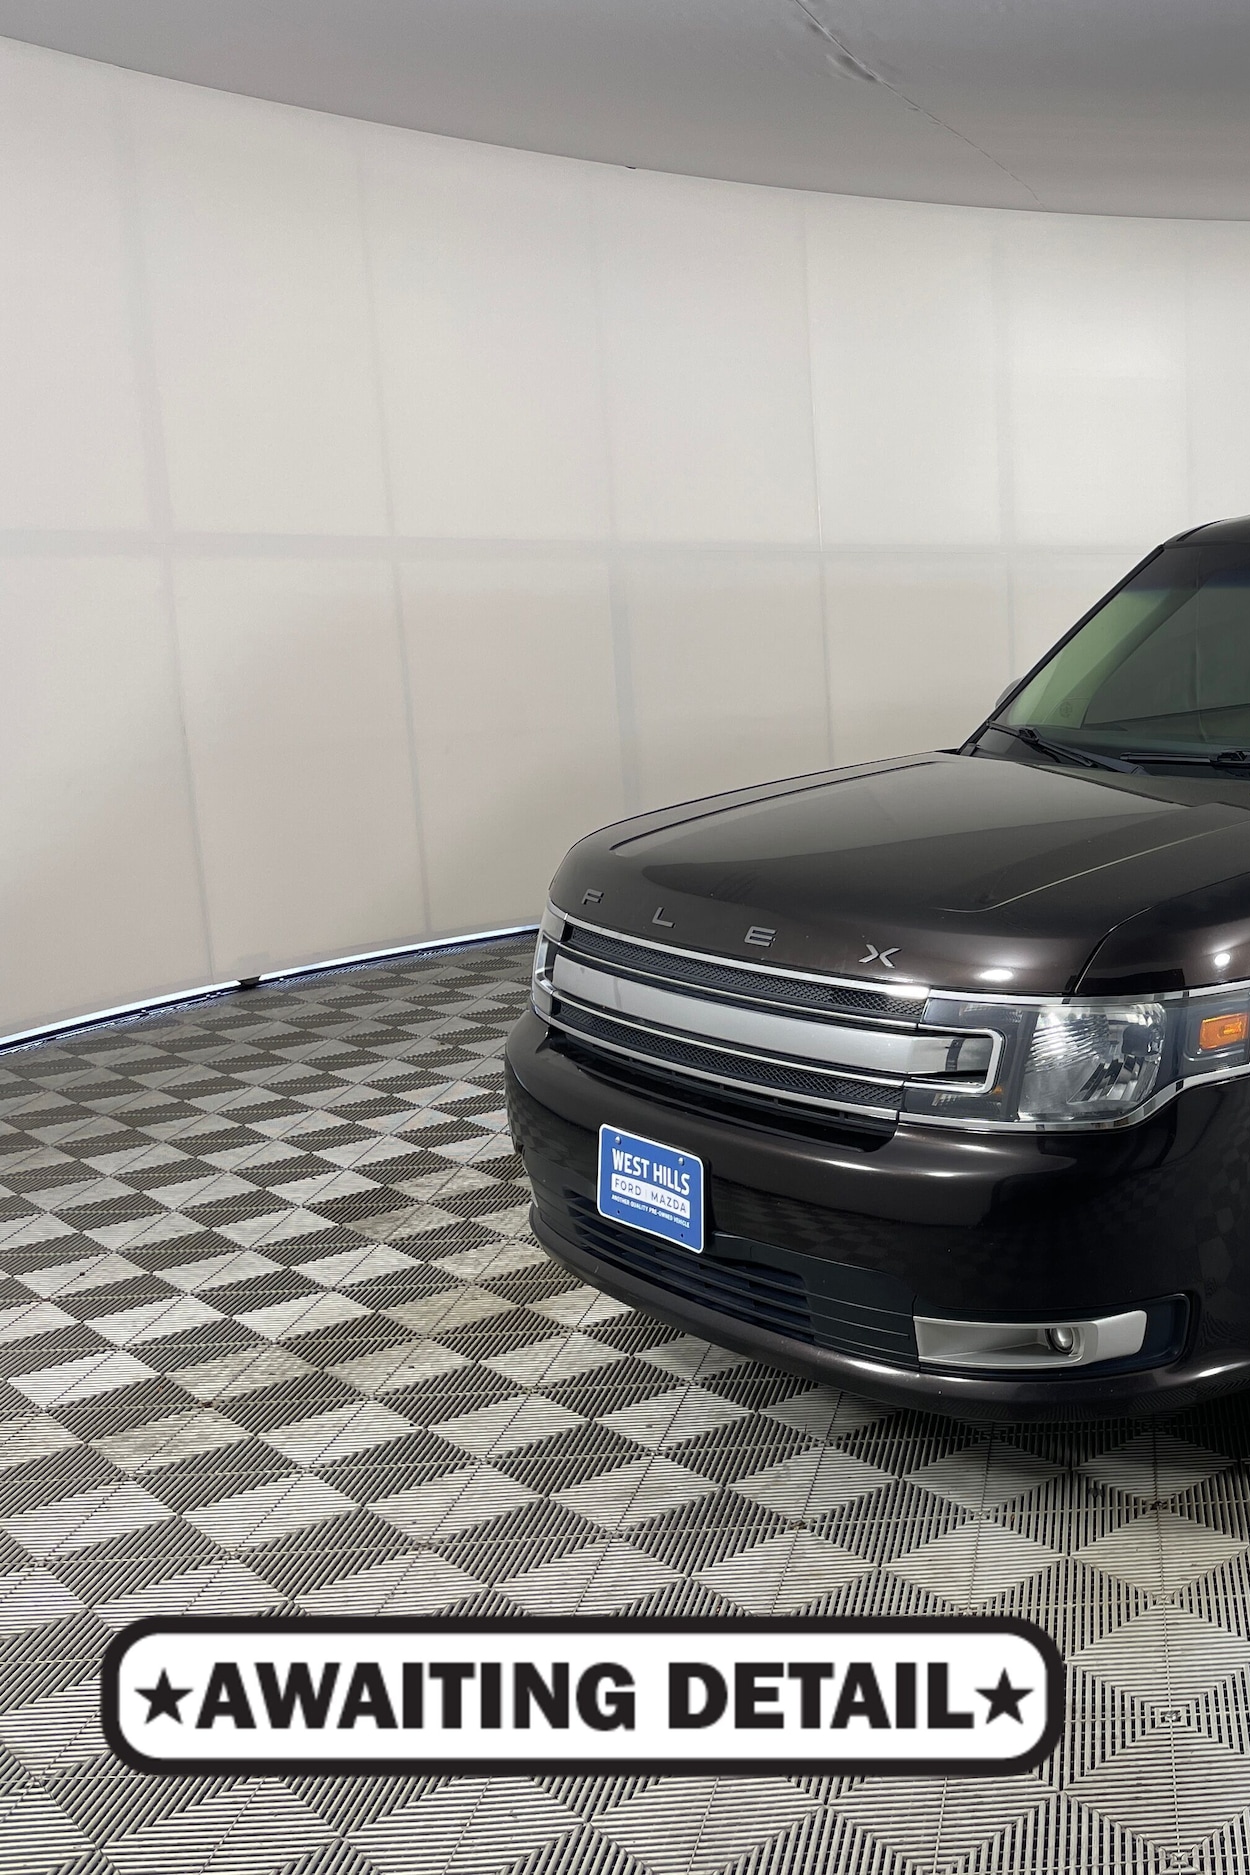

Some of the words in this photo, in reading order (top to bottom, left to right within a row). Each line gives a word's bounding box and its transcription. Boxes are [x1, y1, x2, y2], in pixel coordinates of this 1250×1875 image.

[581, 888, 902, 969] FLEX
[612, 1148, 650, 1178] WEST
[653, 1163, 690, 1195] HILLS
[615, 1178, 641, 1195] FORD
[651, 1191, 687, 1214] MAZDA
[630, 1201, 648, 1212] QUALITY
[648, 1207, 673, 1221] PRE-OWNED
[673, 1216, 690, 1228] VEHICLE
